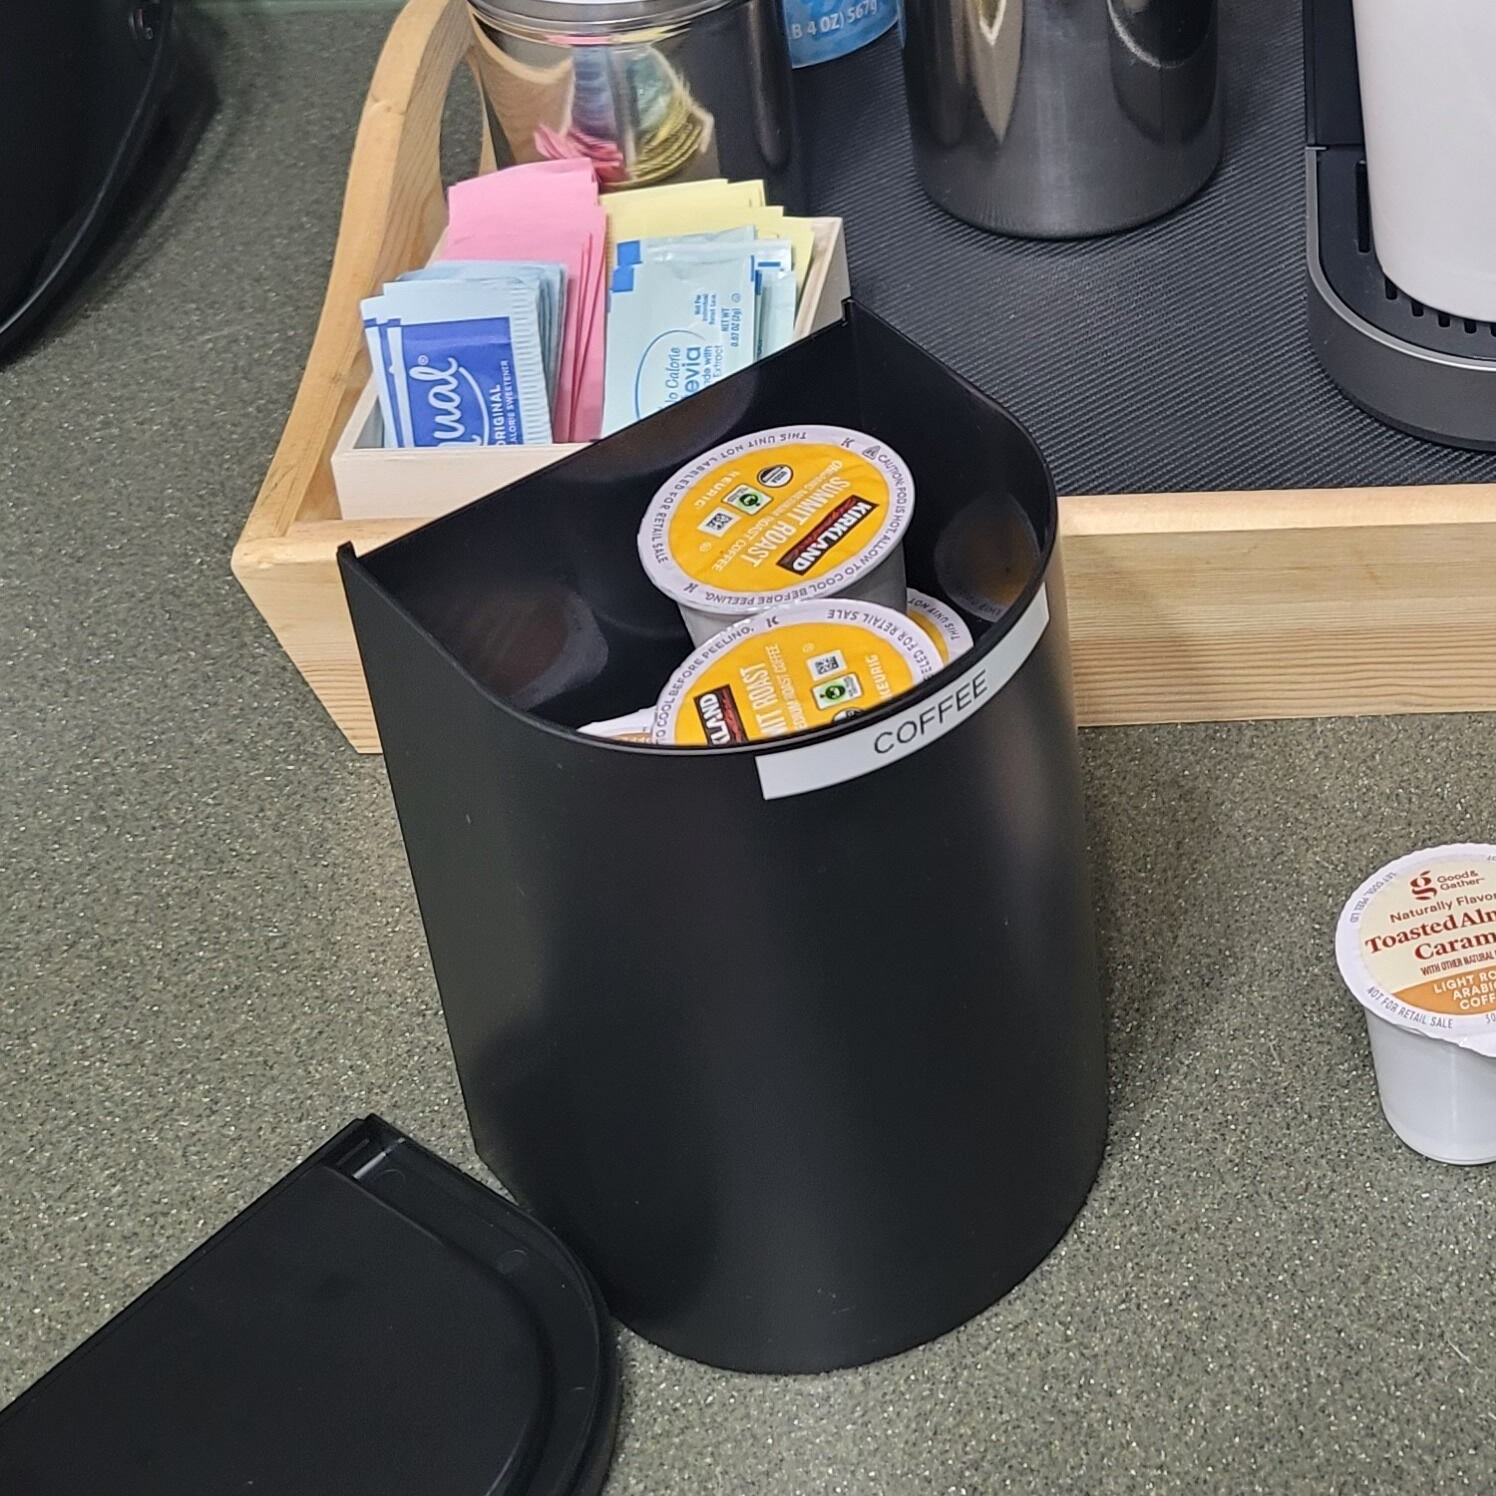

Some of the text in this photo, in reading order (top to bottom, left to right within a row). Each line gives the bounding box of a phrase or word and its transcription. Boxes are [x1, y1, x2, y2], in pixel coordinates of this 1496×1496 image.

[807, 21, 816, 35] 4
[820, 11, 845, 32] OZ)
[665, 347, 681, 389] Calorie
[704, 345, 713, 366] with
[713, 345, 724, 377] Extract
[681, 347, 701, 394] evia
[500, 360, 519, 446] ALORIE SWEETENER
[748, 435, 775, 449] UNIT
[780, 432, 807, 441] THIS
[721, 443, 744, 459] NOT
[674, 456, 718, 491] LABELED
[660, 491, 677, 511] FOR
[787, 476, 850, 526] SUMMIT
[741, 520, 797, 568] ROAST
[792, 502, 873, 571] KIRKLAND
[712, 539, 746, 572] COFFEE
[861, 536, 891, 566] ALLOW
[844, 563, 861, 576] TO
[757, 587, 807, 606] BEFORE
[807, 573, 844, 597] COOL
[827, 609, 858, 621] SALE
[863, 613, 901, 636] RETAIL
[908, 597, 961, 641] THIS UNIT NOT
[897, 631, 918, 651] FOR
[657, 697, 676, 727] COOL
[669, 658, 705, 698] BEFORE
[740, 663, 778, 710] ROAST
[873, 669, 989, 755] COFFEE
[1440, 878, 1482, 891] Gather
[1390, 900, 1454, 924] Naturally
[1365, 910, 1459, 954] Toasted
[1420, 963, 1440, 977] WITH
[1440, 958, 1463, 972] OTHER
[1463, 951, 1495, 967] NATURAL
[1433, 974, 1475, 995] LIGHT
[1367, 986, 1454, 1029] NOT FOR RETAIL SALE
